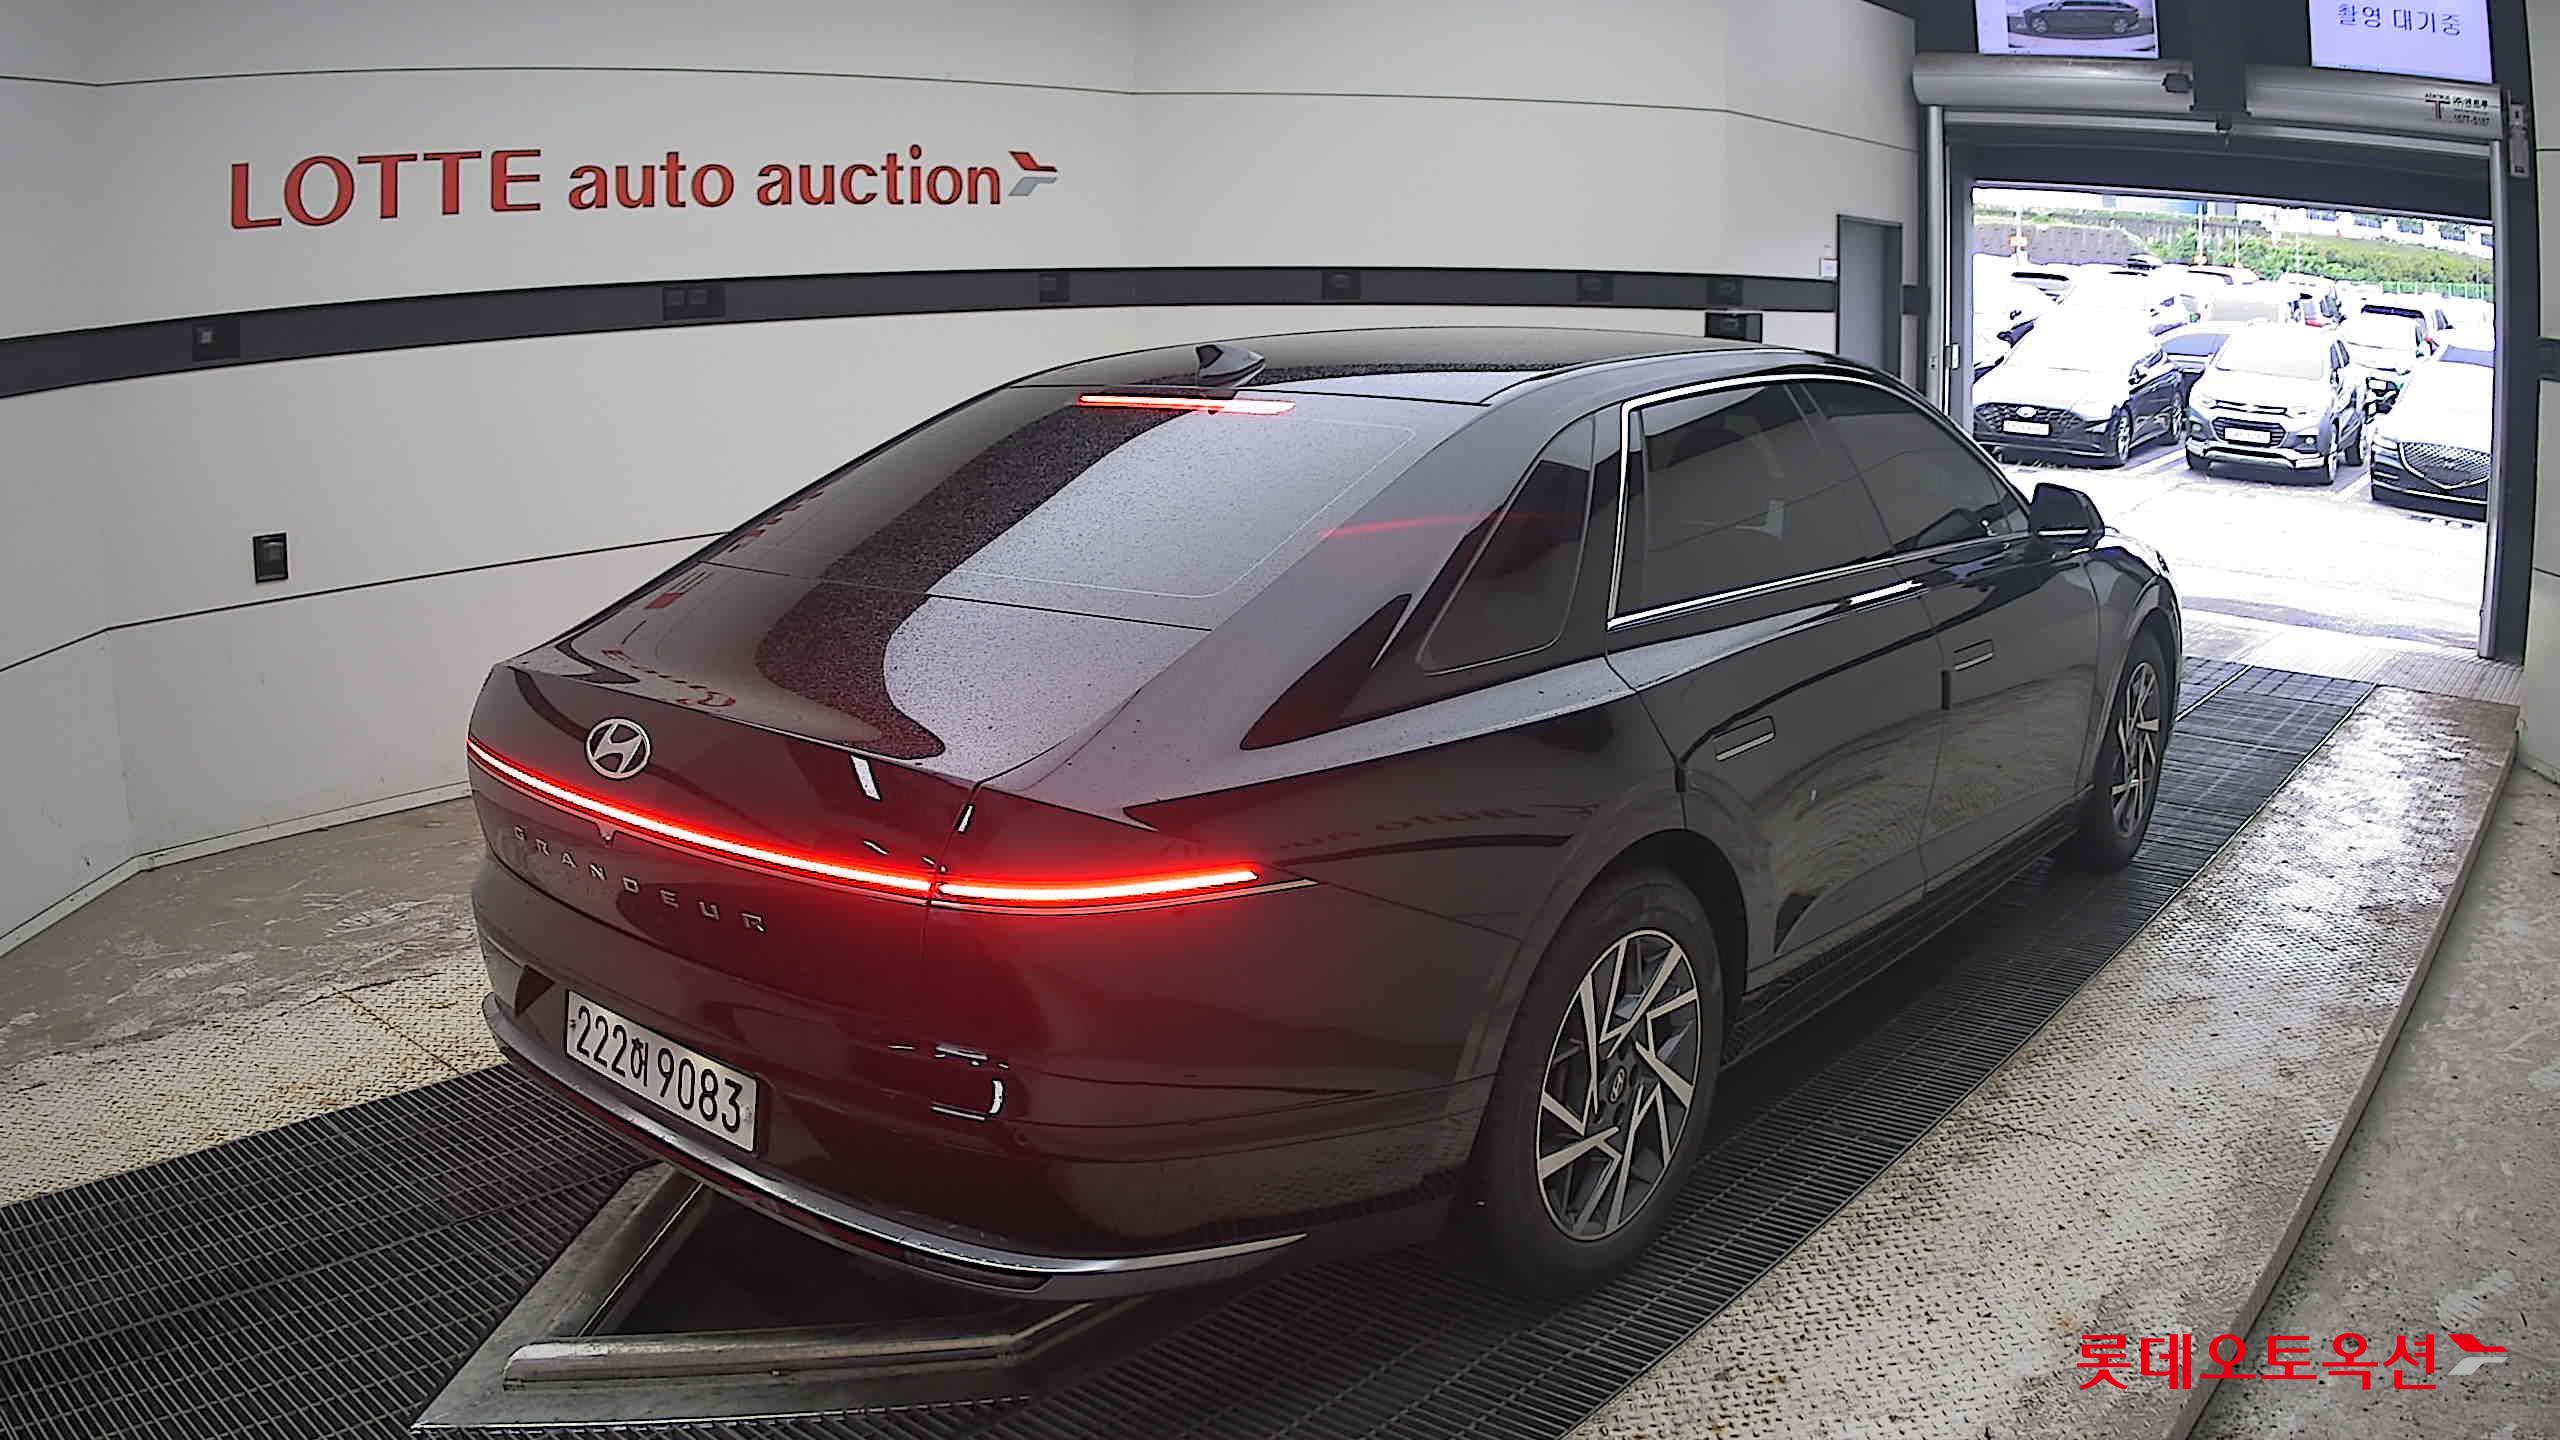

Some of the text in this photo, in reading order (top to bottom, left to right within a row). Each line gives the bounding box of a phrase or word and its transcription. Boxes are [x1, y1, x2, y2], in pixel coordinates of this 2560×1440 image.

[338, 4, 461, 37] 촬영 대기중
[230, 145, 1003, 230] LOTTE auto auction
[513, 822, 769, 934] GRANDEUR
